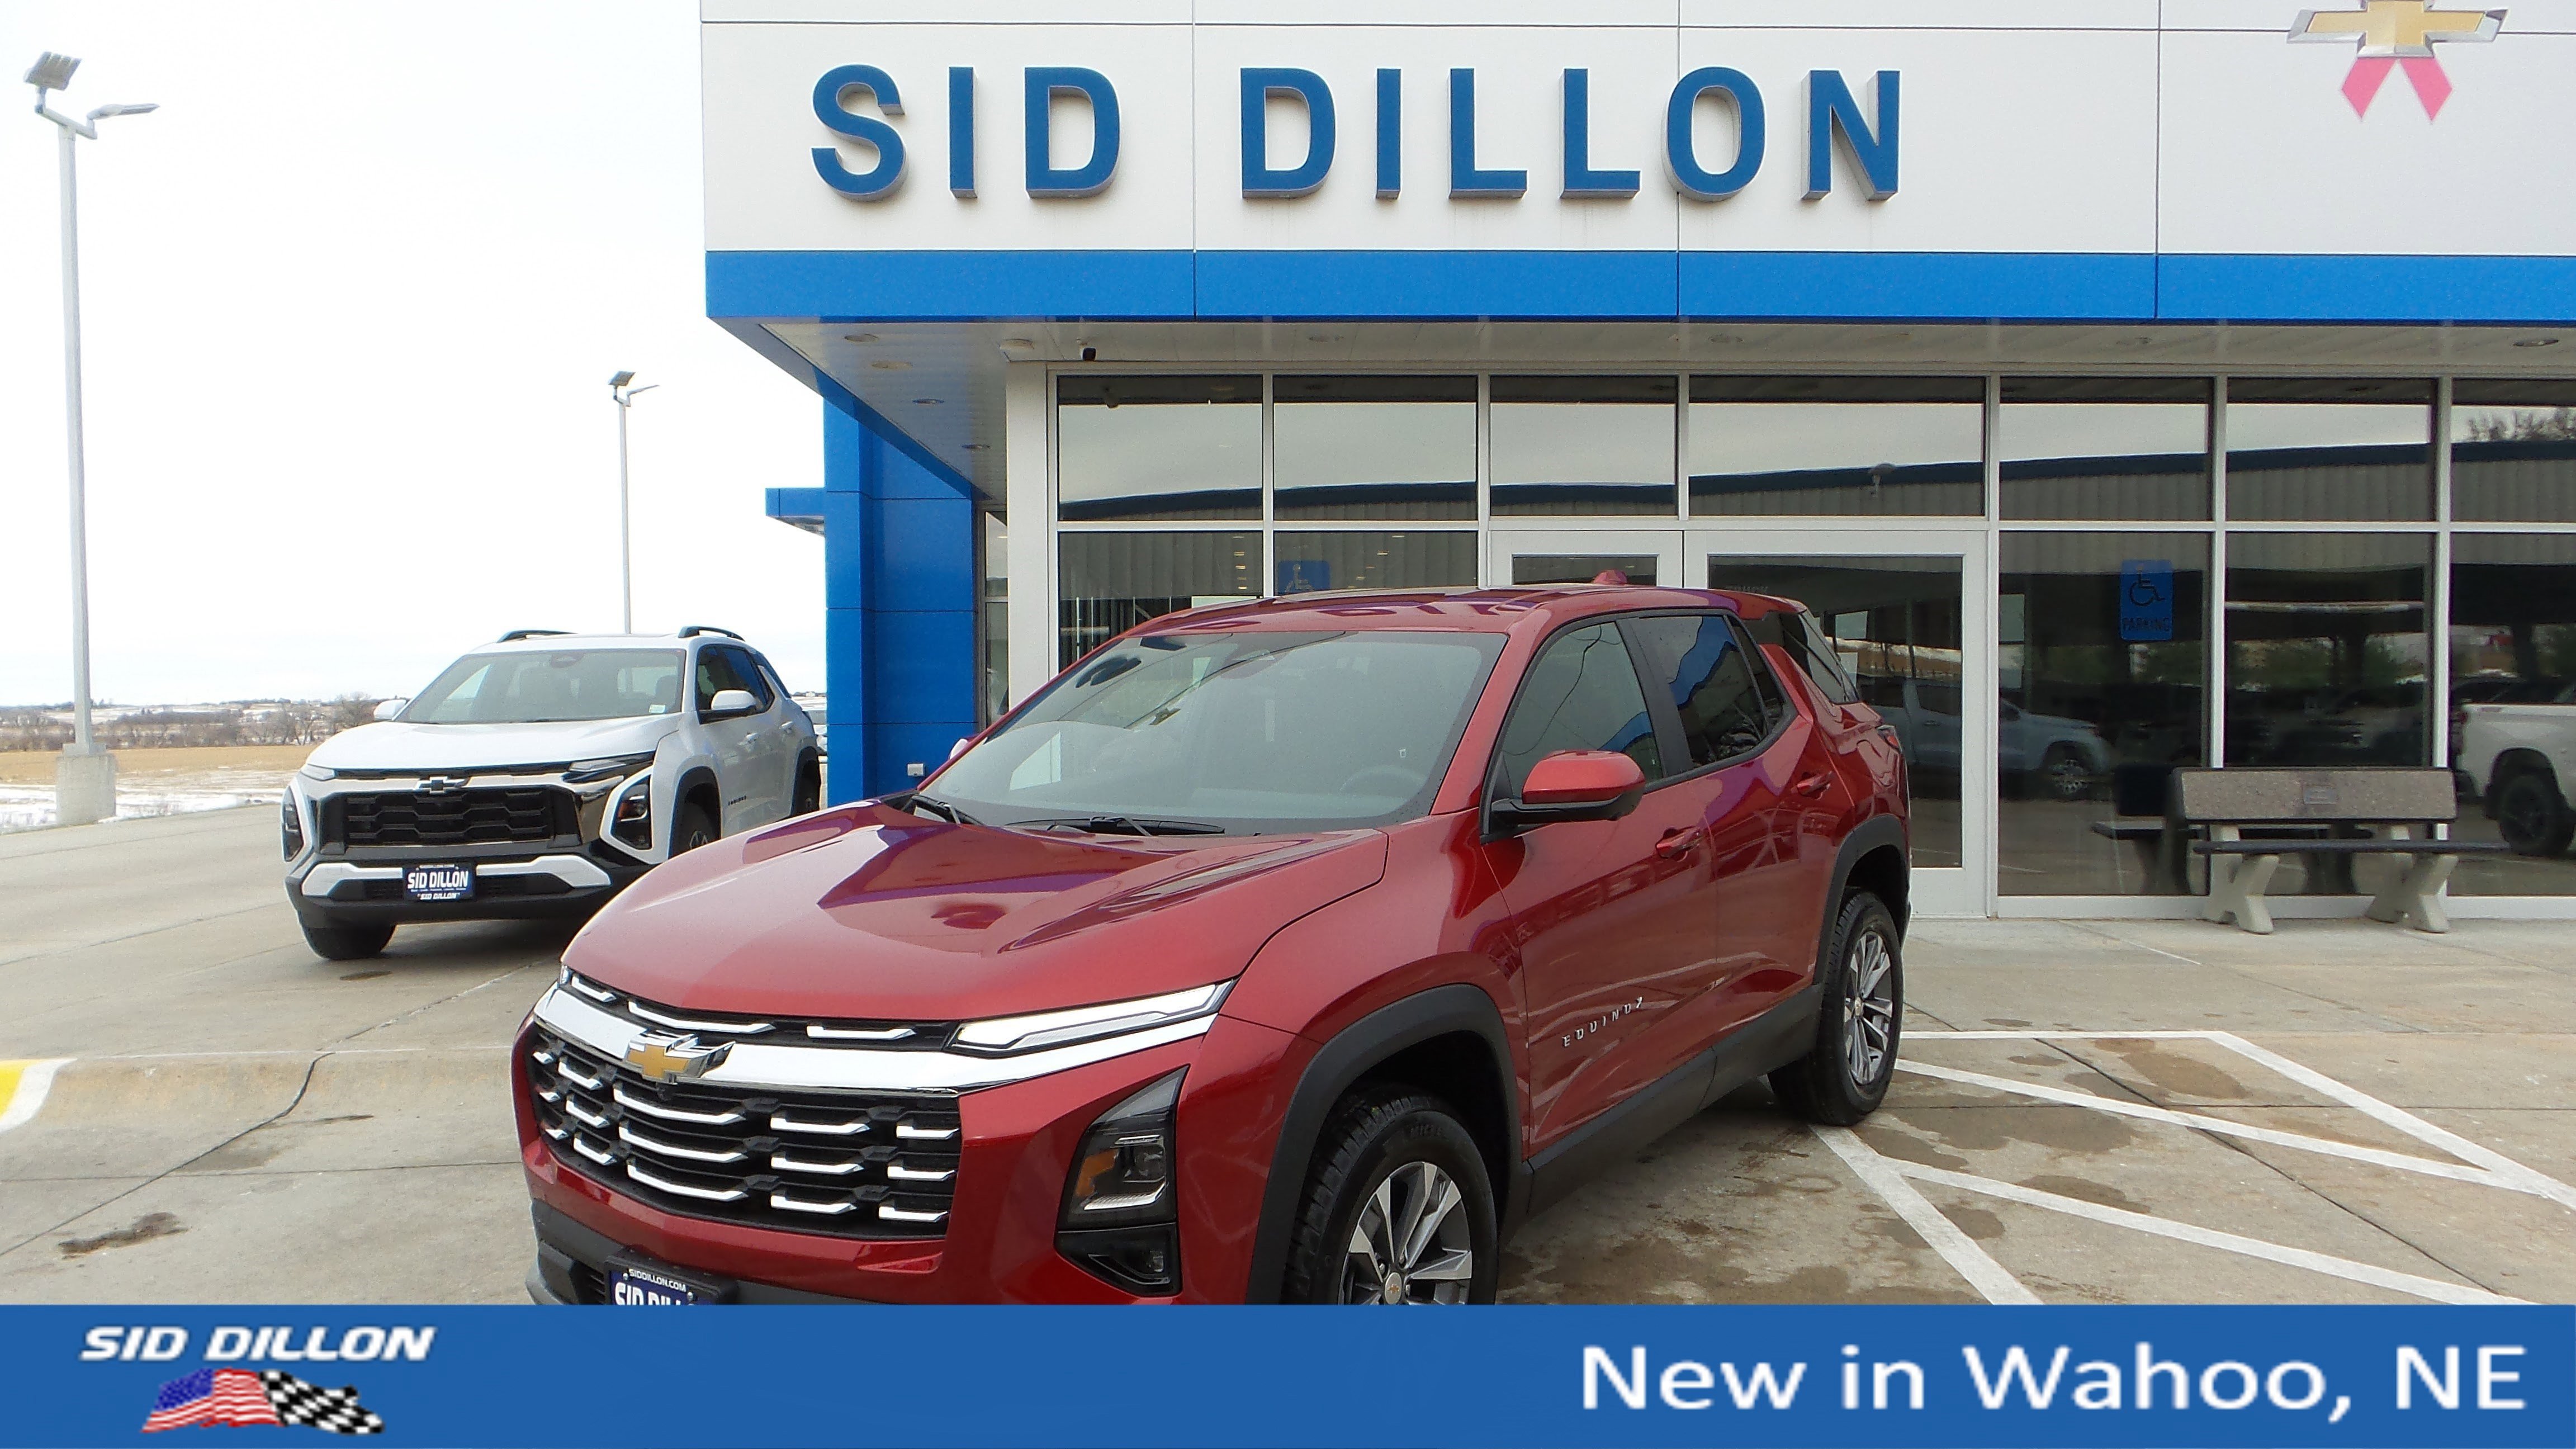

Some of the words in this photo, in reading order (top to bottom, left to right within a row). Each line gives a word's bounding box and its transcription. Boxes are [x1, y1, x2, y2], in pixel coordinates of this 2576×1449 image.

[812, 65, 1120, 199] SID
[1241, 66, 1900, 200] DILLON
[408, 872, 428, 889] SID
[429, 871, 468, 888] DILLON
[1561, 996, 1643, 1047] EQUINOX
[628, 1268, 687, 1292] SIDDILLON.COM
